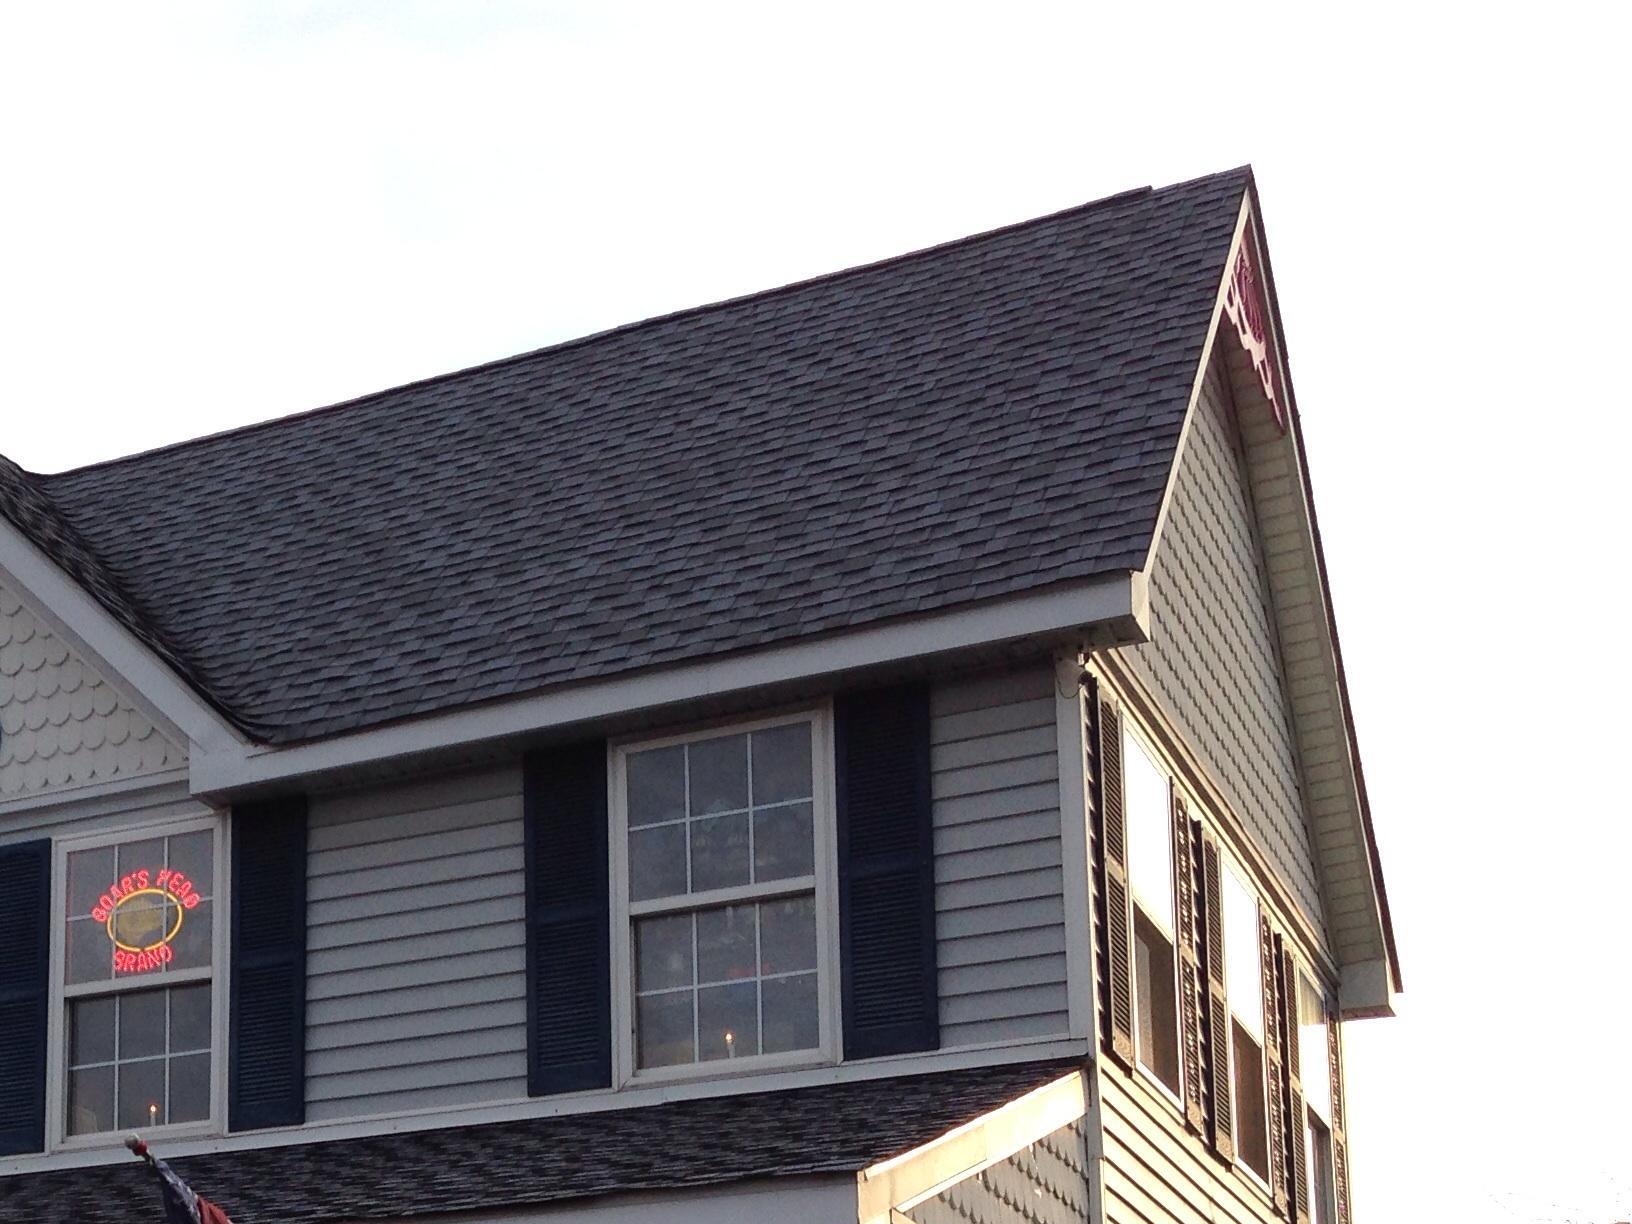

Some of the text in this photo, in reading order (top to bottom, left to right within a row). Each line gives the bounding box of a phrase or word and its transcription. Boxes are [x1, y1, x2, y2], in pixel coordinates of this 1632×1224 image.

[91, 867, 201, 923] BOAR'S HEAD
[113, 945, 173, 973] BRAND
